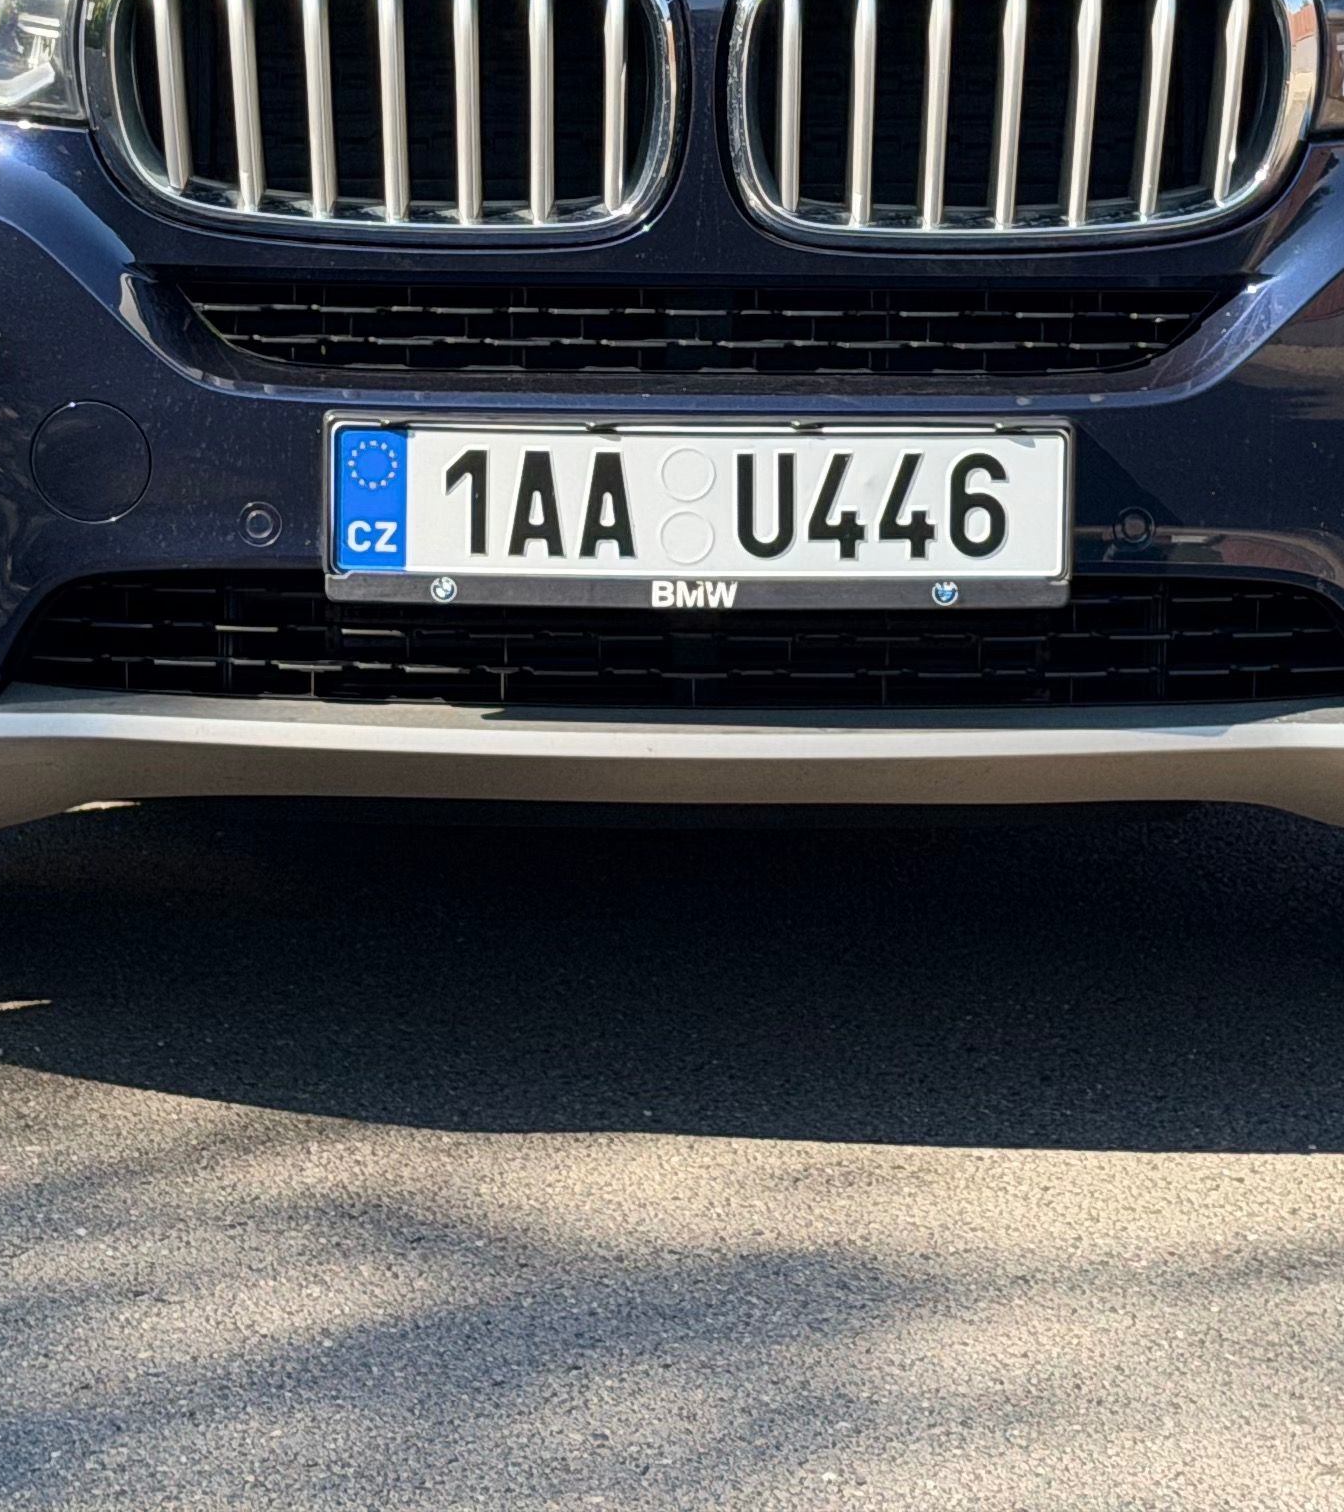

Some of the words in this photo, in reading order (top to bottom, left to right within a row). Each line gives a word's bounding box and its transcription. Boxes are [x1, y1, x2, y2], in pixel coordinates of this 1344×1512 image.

[444, 448, 637, 558] 1AA
[736, 449, 1009, 559] U446
[346, 520, 398, 554] CZ
[651, 580, 738, 608] BMW
